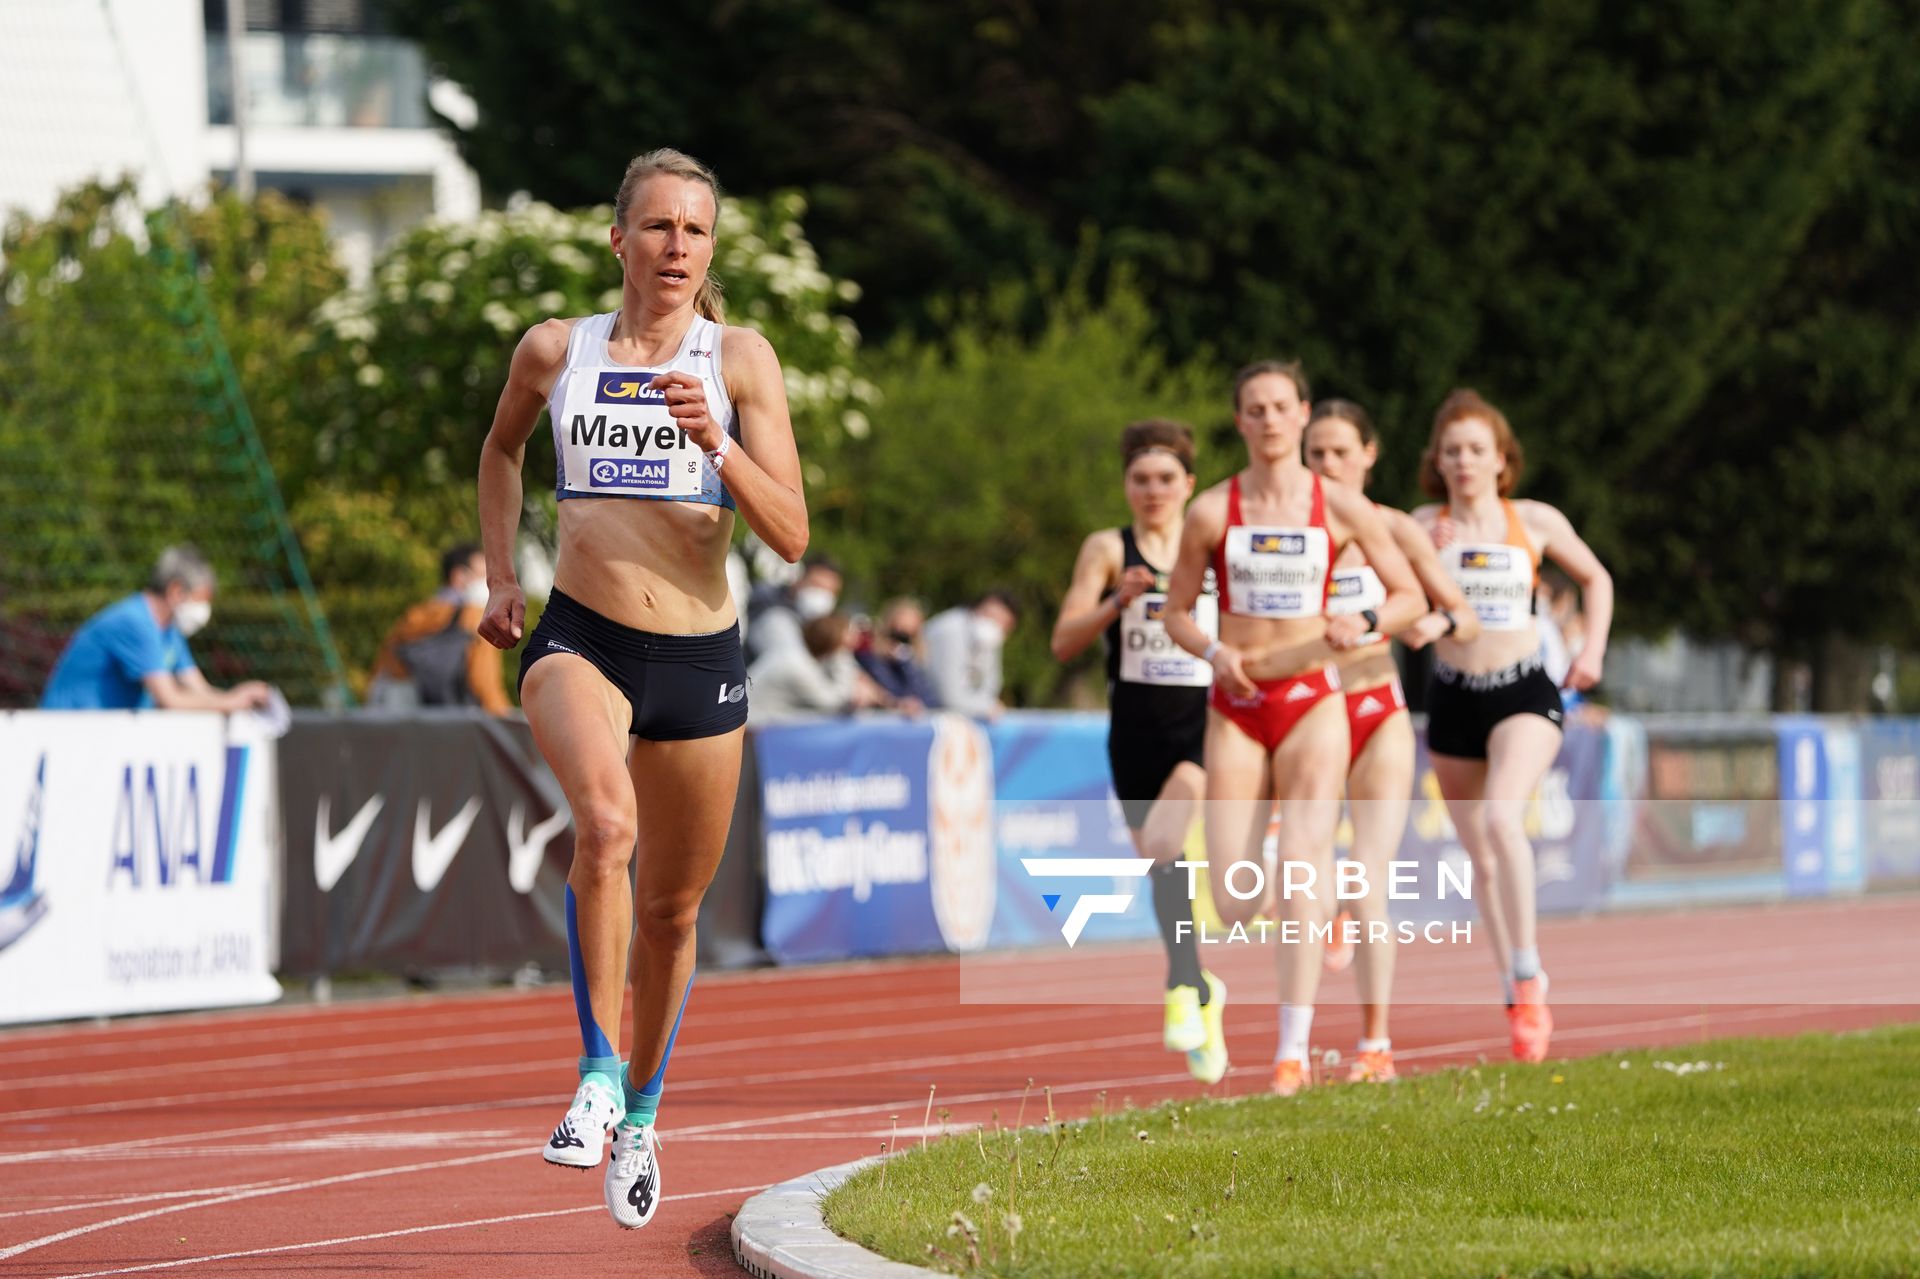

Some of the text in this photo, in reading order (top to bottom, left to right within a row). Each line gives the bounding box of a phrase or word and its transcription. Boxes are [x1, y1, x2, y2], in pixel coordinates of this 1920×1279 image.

[570, 414, 688, 456] Mayer
[621, 464, 666, 479] PLAN
[687, 461, 697, 474] 59
[107, 763, 203, 888] ANA
